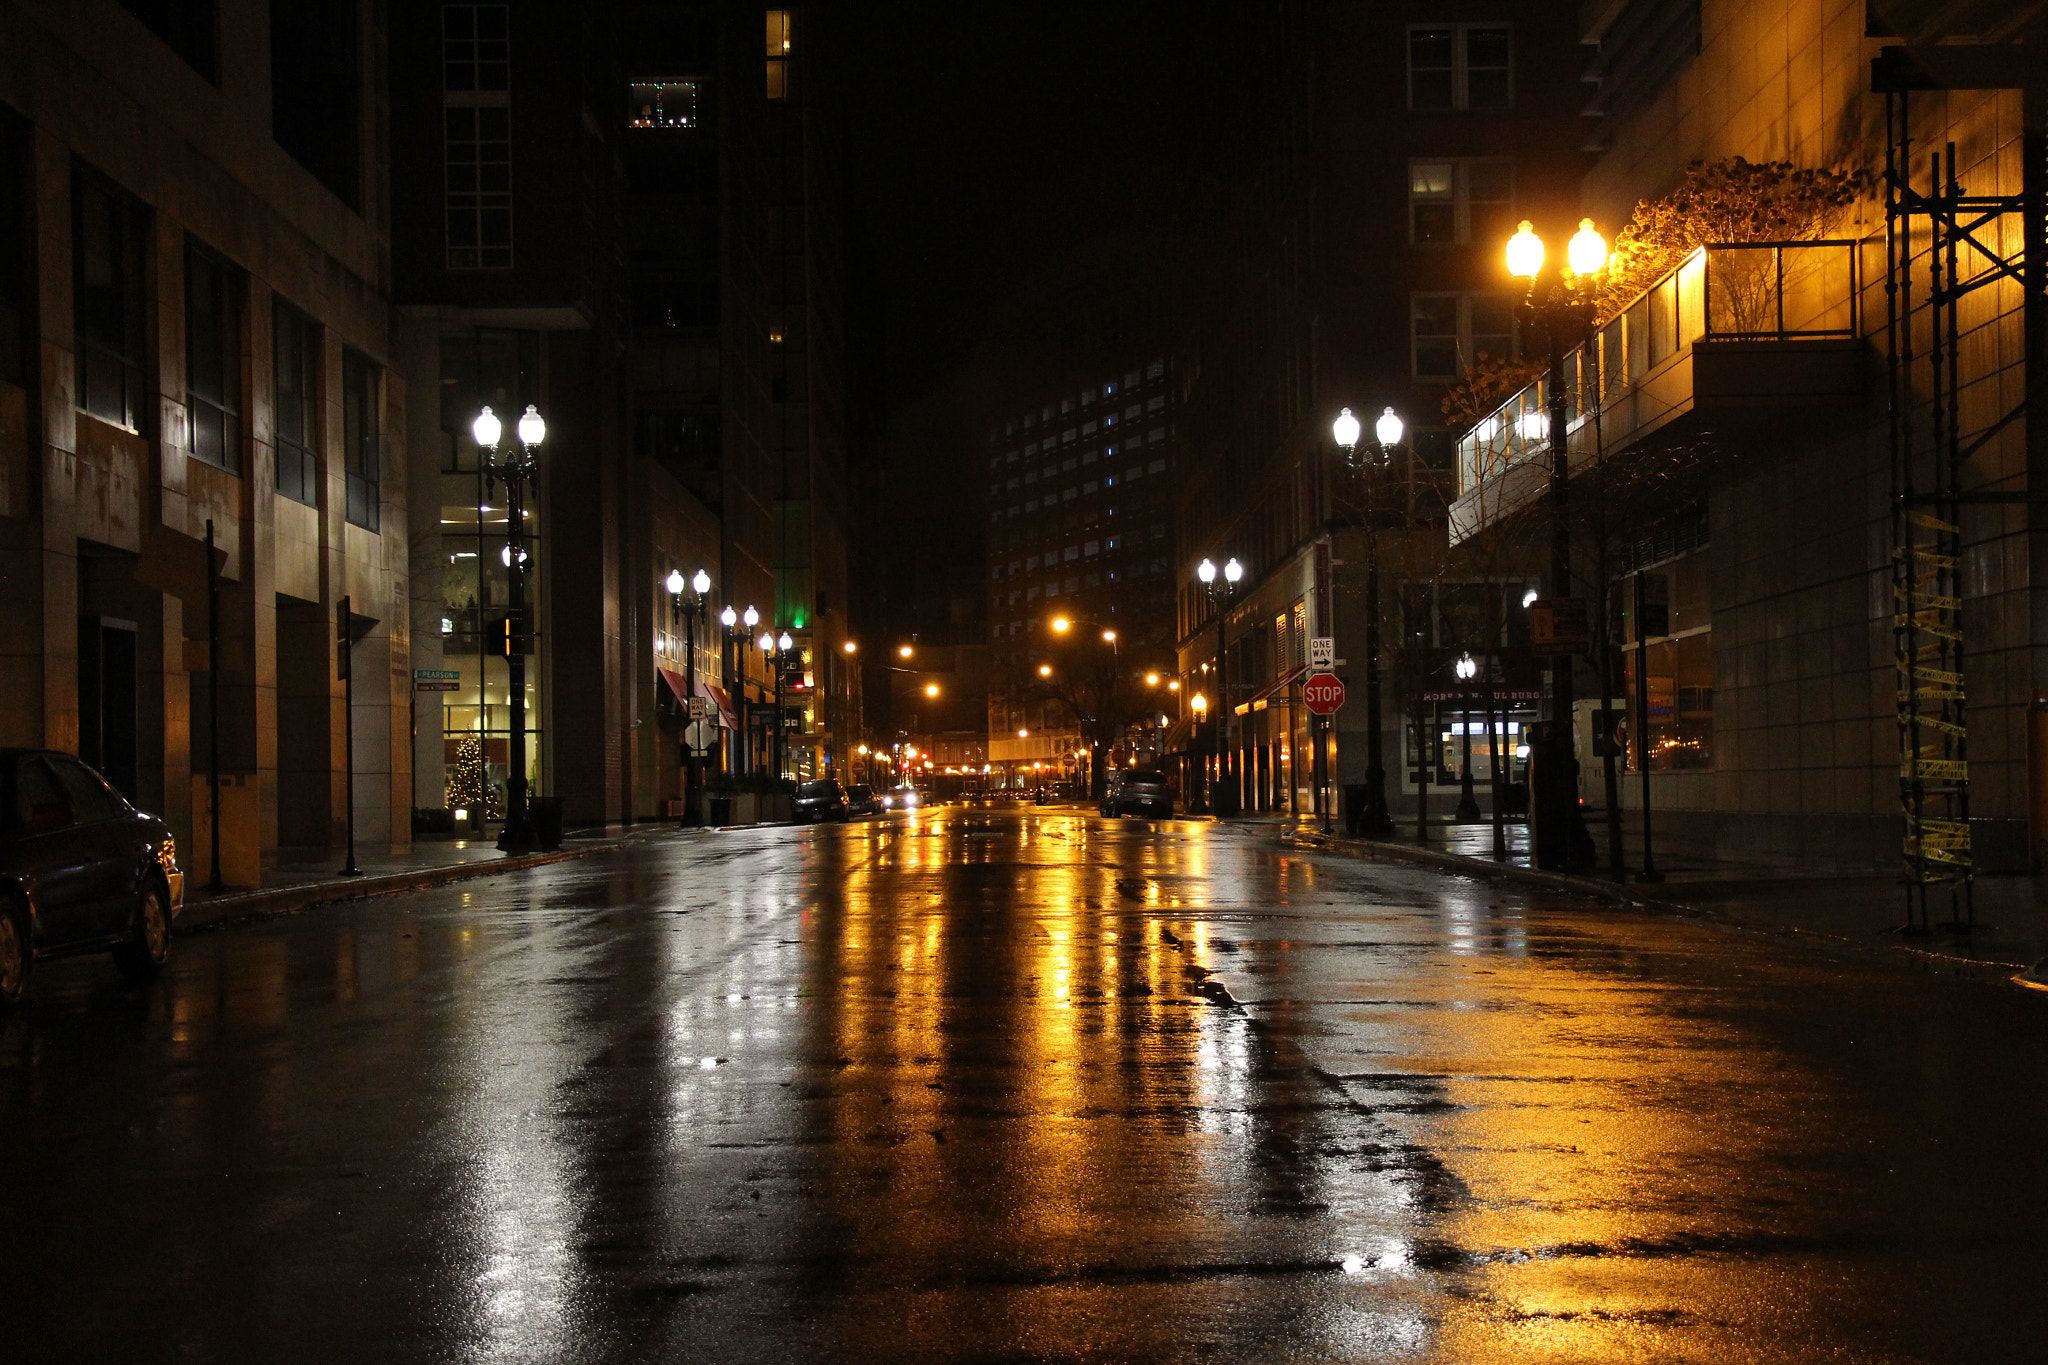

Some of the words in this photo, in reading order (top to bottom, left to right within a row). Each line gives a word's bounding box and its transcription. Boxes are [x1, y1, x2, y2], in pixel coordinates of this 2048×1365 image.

[1313, 640, 1331, 648] ONE
[1313, 649, 1331, 657] WAY
[422, 671, 454, 679] PEARSON
[1306, 686, 1342, 702] STOP
